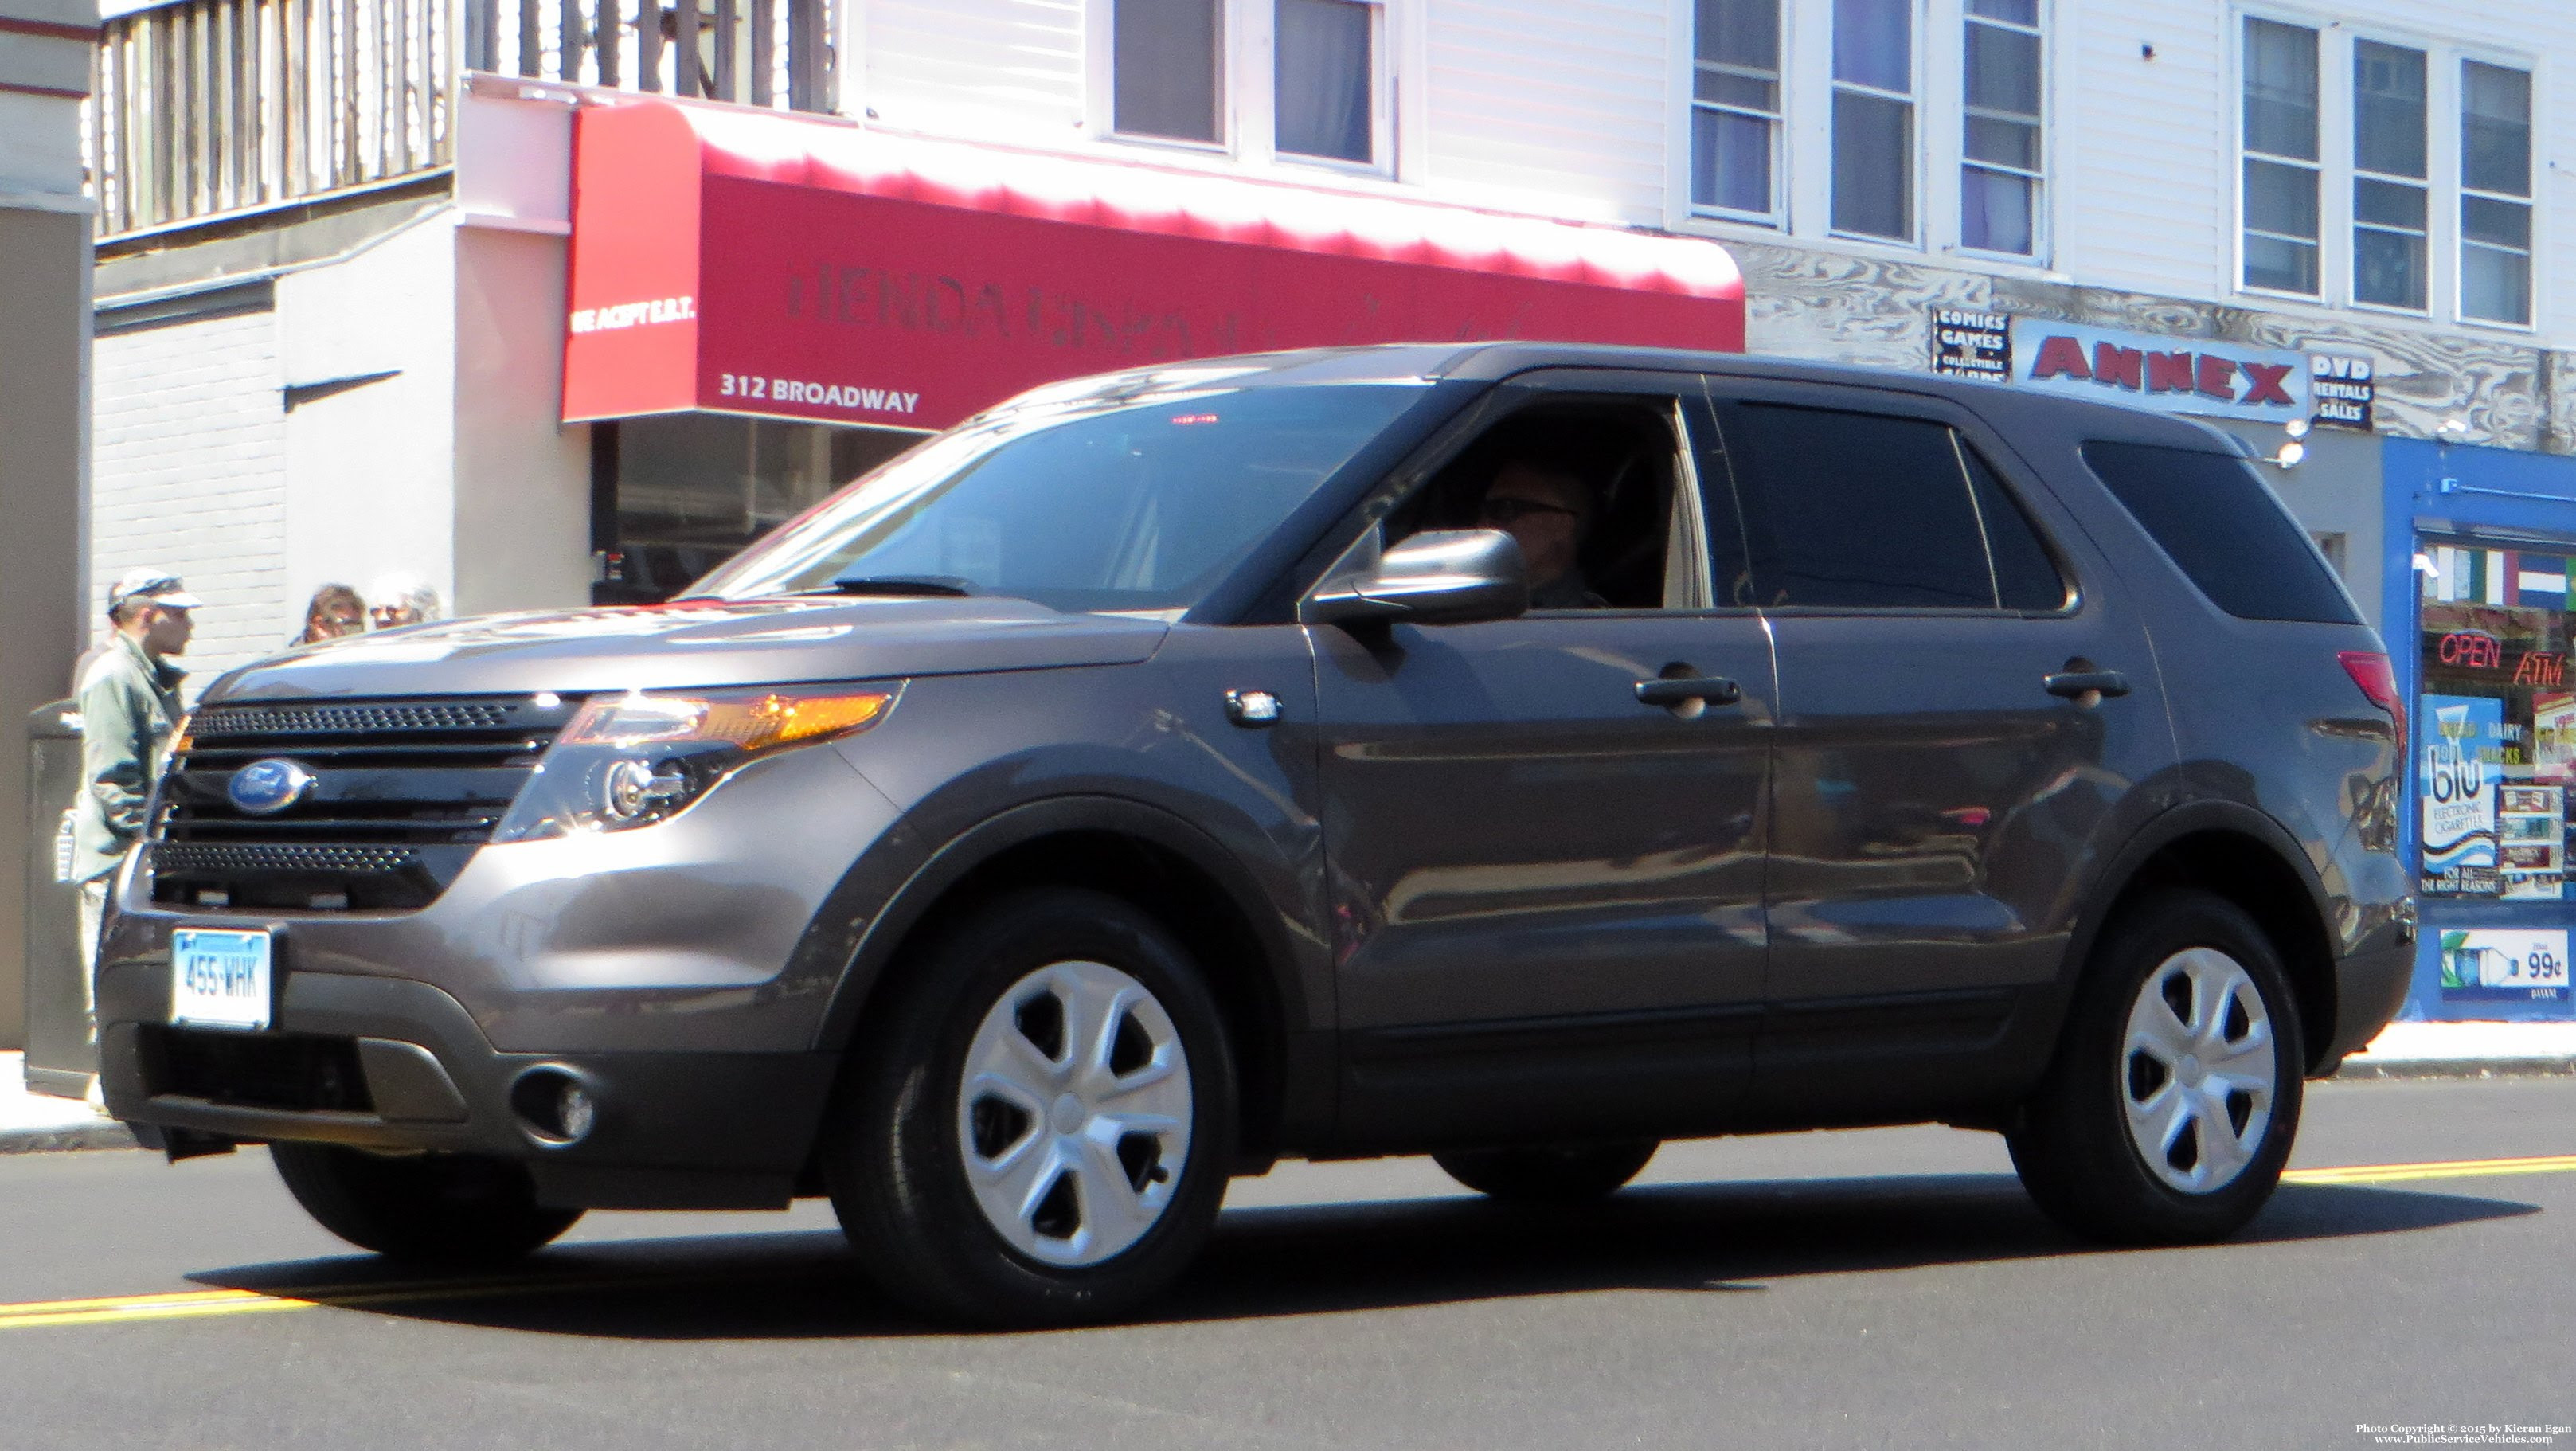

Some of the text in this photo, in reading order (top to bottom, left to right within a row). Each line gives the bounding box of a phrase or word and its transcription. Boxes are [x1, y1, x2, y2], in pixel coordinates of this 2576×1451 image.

[1939, 311, 2007, 330] COMICS
[1941, 329, 2003, 350] GAMES
[1942, 355, 2003, 370] COLLECTIBLE
[2028, 335, 2296, 407] ANNEX
[2312, 355, 2371, 380] DVD
[720, 374, 919, 413] 312 BROADWAY
[2312, 382, 2370, 401] RENTALS
[2320, 403, 2363, 420] SALES
[2440, 634, 2501, 668] OPEN
[2513, 651, 2565, 686] ATM
[2429, 743, 2483, 804] blu
[2444, 866, 2459, 879] FOR
[2422, 878, 2435, 892] THE
[2528, 952, 2562, 979] 99¢
